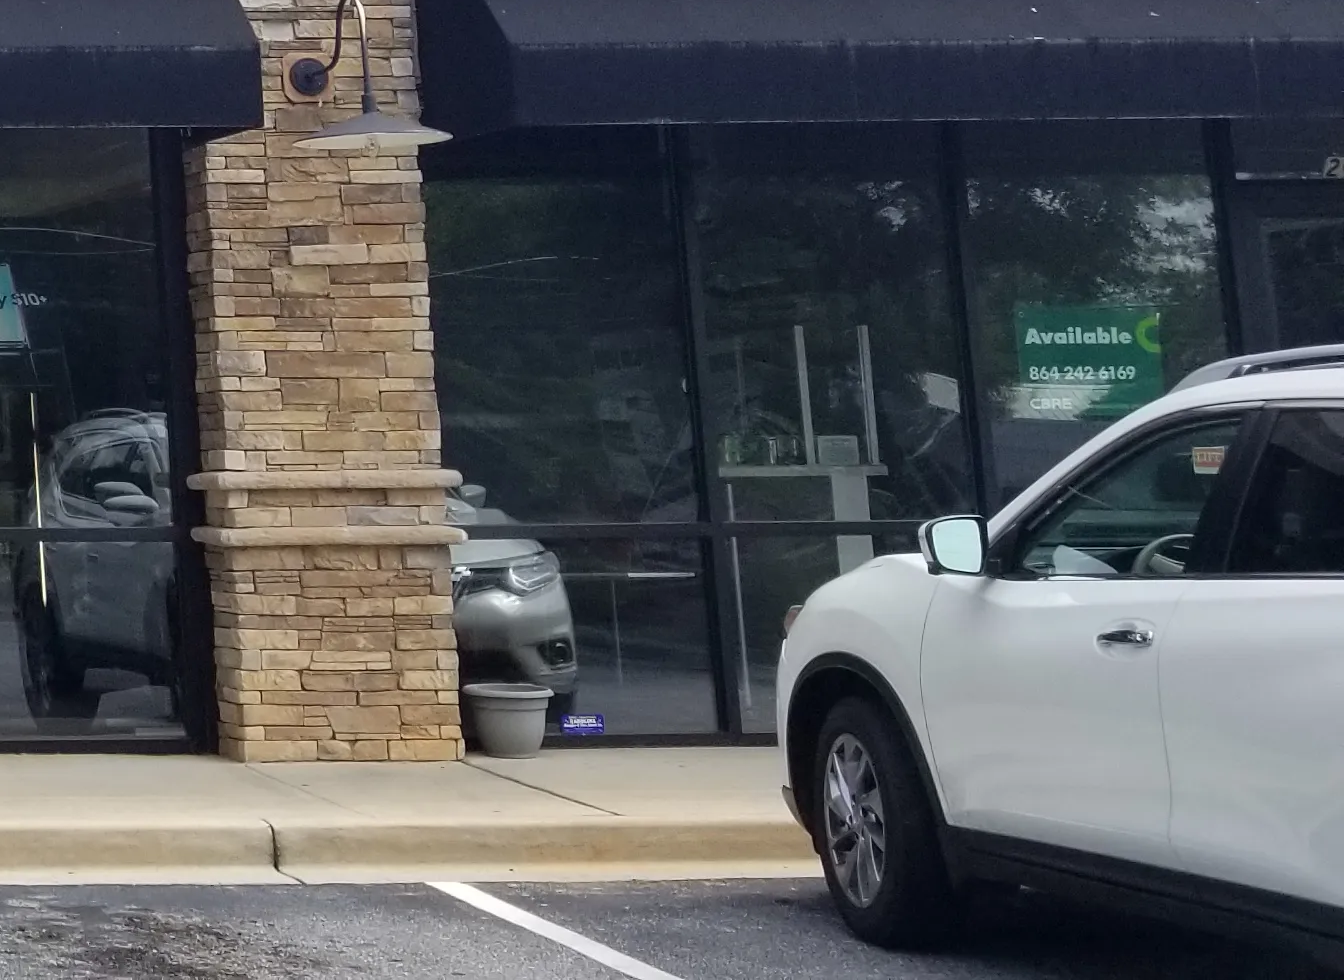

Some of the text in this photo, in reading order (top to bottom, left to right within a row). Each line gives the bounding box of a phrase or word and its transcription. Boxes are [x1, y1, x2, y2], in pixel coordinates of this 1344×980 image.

[12, 292, 48, 307] S10+
[1024, 326, 1133, 345] Available
[1029, 365, 1136, 381] 864 242 6169
[1029, 398, 1073, 410] CBRE
